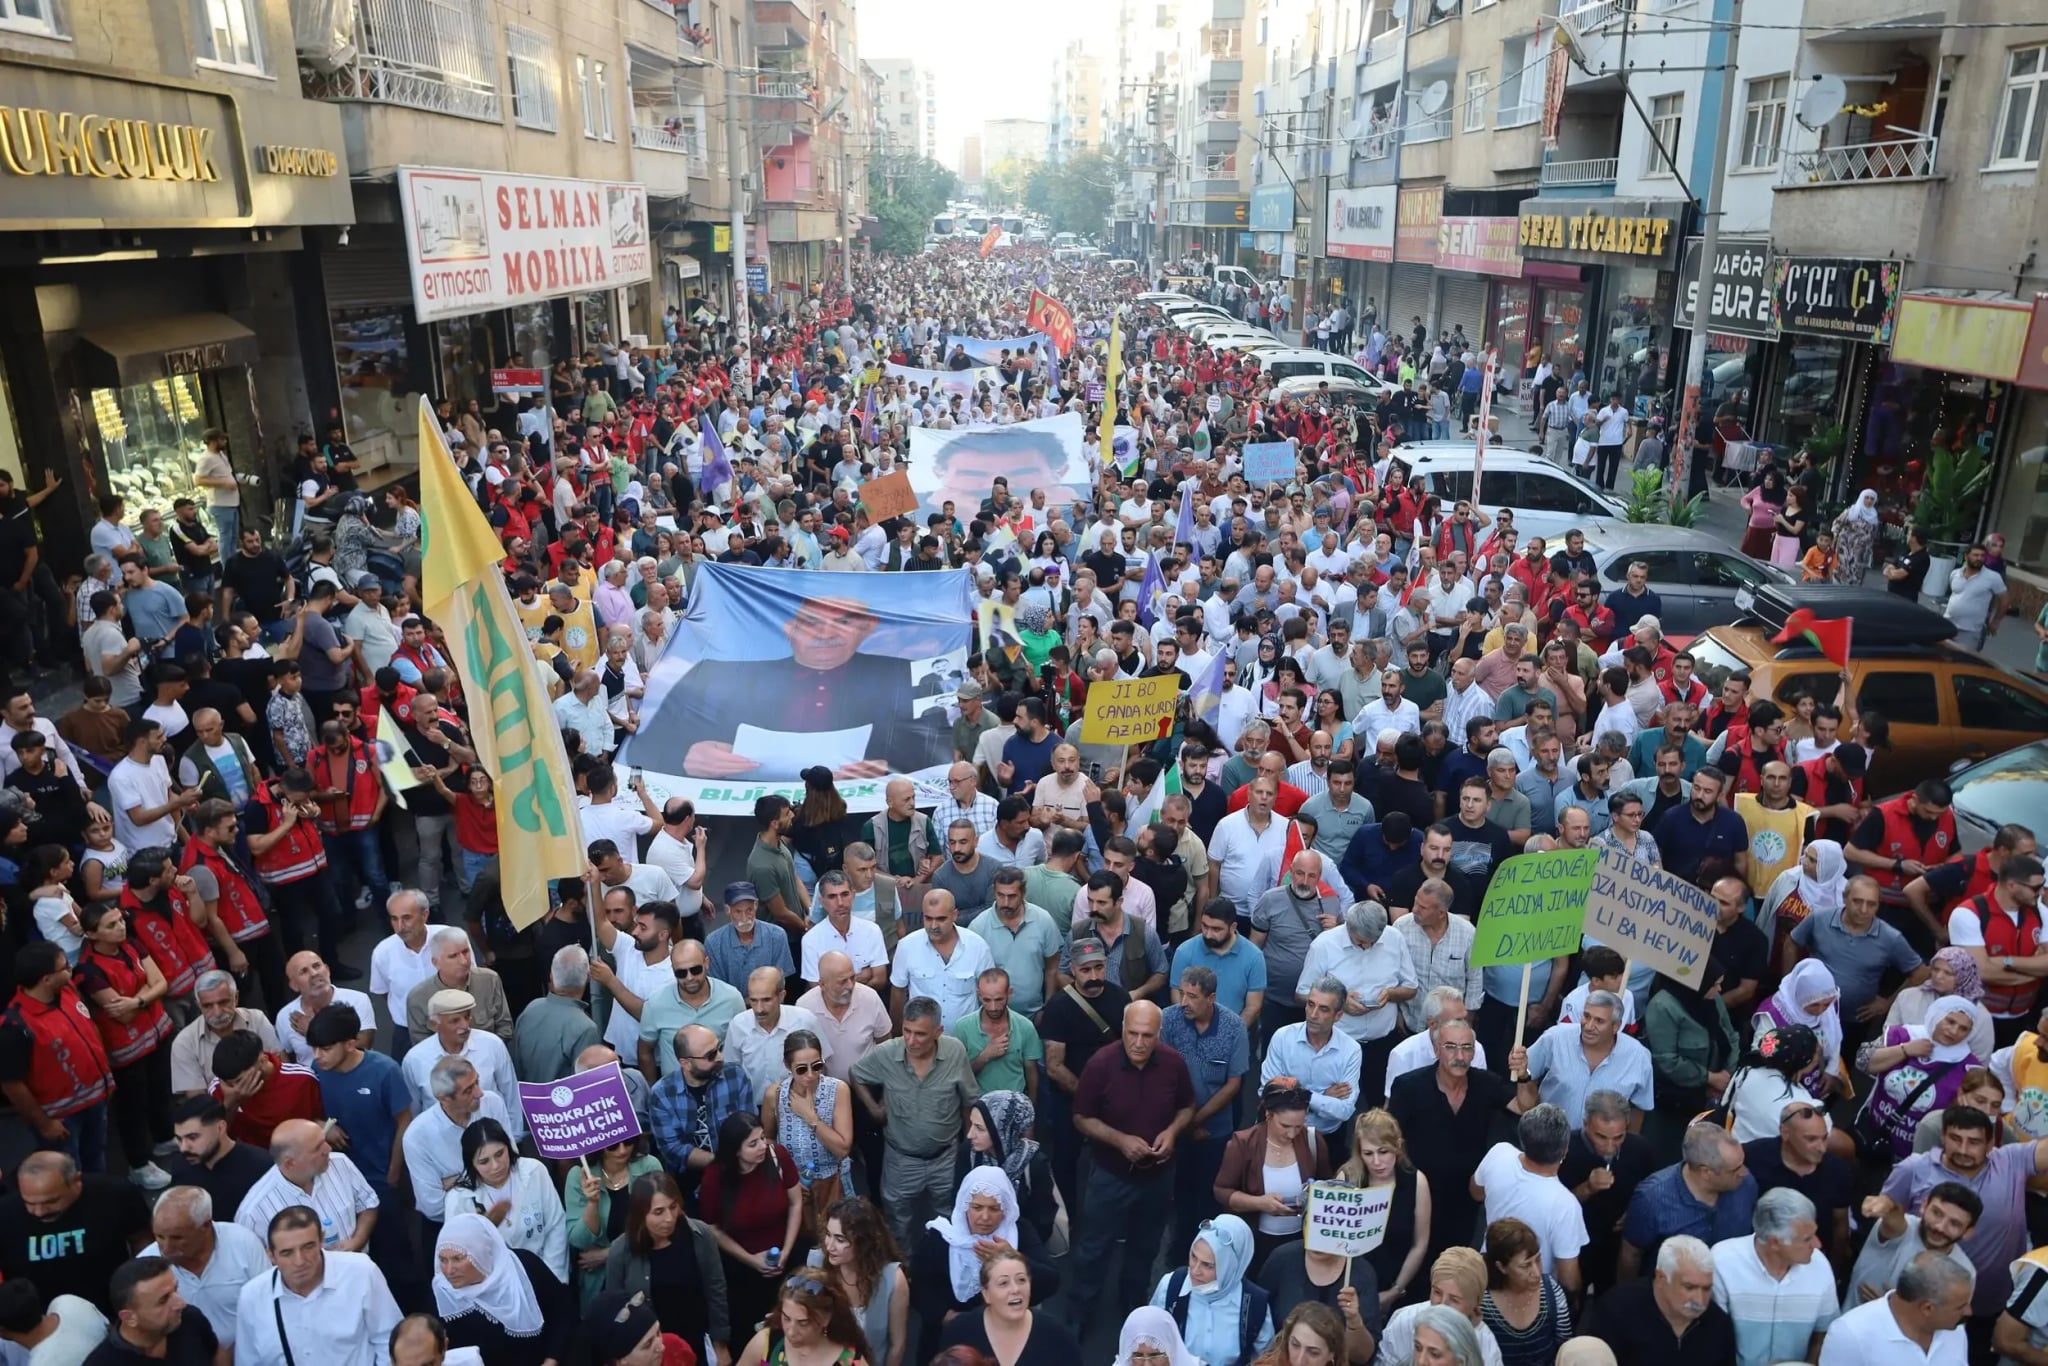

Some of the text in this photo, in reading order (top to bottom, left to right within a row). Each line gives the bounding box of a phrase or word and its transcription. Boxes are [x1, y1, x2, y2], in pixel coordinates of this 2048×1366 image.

[496, 185, 601, 231] SELMAN
[1519, 208, 1670, 256] SEFA TİCARET
[503, 239, 607, 296] MOBİLYA
[423, 267, 492, 300] ermosan
[1685, 281, 1755, 320] SBUR
[1111, 681, 1157, 699] JI BO
[1097, 704, 1140, 720] ÇANDA
[1493, 865, 1517, 889] EM
[1547, 887, 1590, 912] JINAN
[1596, 906, 1614, 927] LI
[1617, 916, 1637, 940] BA
[1666, 906, 1714, 943] JINAN
[531, 1096, 618, 1124] DEMOKRATİK
[537, 1109, 624, 1142] ÇÖZÜM İÇİN
[542, 1125, 628, 1152] KADINLAR YÜRÜYOR!
[1313, 1189, 1363, 1207] BARIŞ
[1323, 1201, 1389, 1217] KADININ
[28, 1229, 87, 1262] LOFT
[1320, 1225, 1383, 1240] GELECEK
